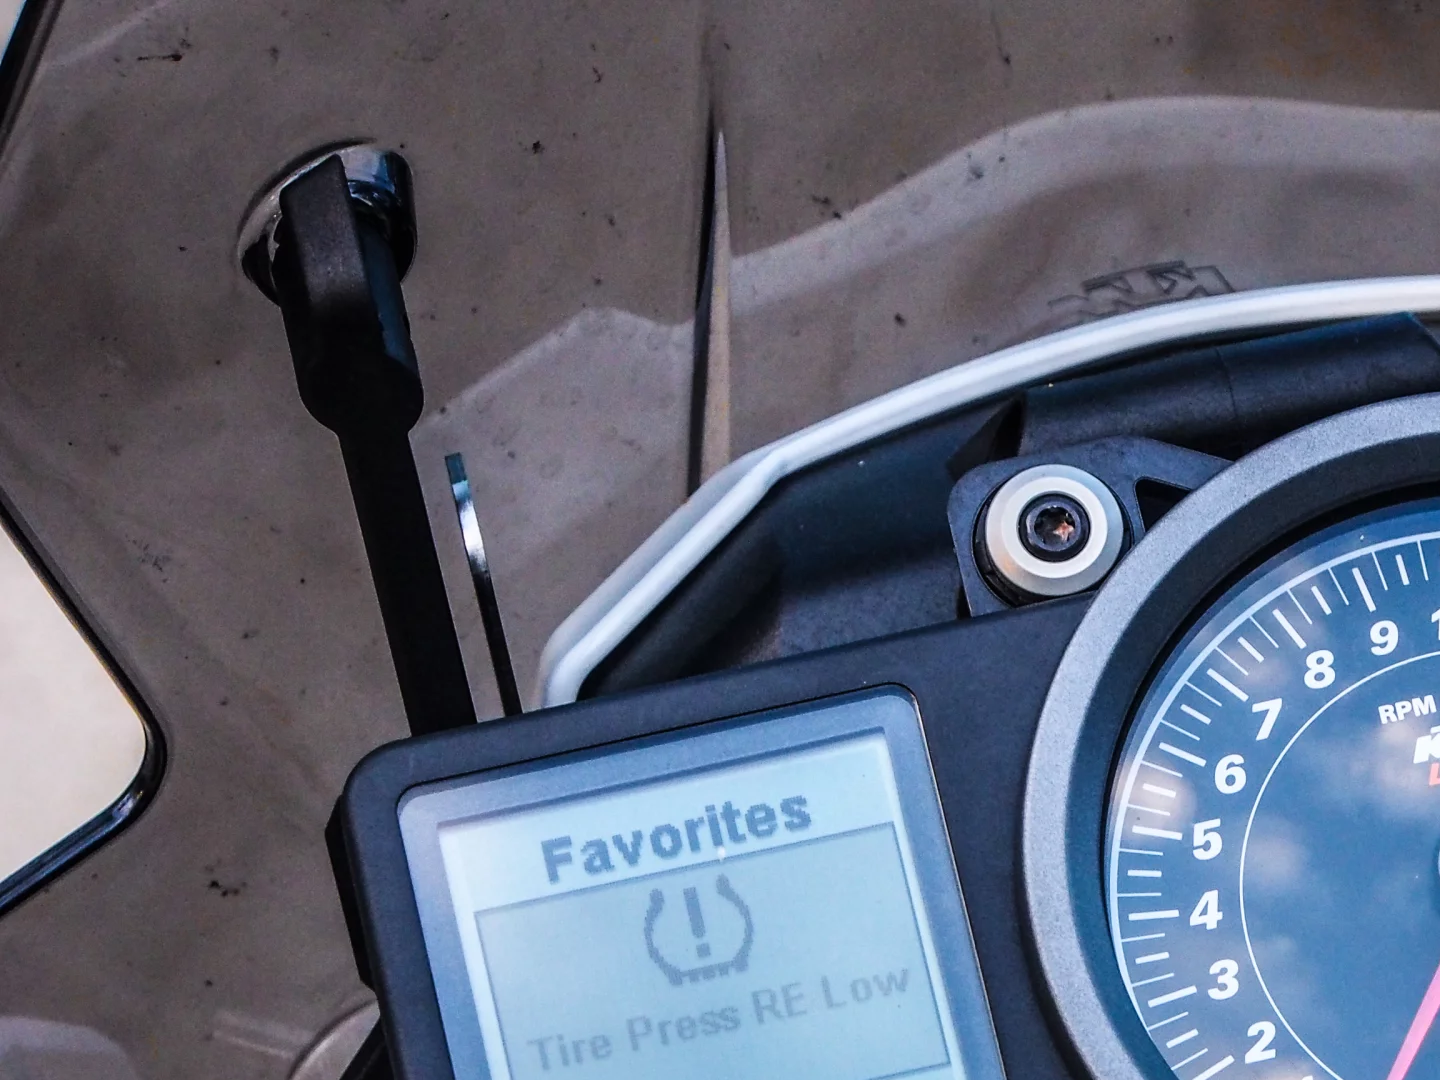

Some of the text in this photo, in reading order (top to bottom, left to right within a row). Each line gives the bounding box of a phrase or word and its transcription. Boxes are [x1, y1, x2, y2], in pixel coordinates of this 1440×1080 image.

[1369, 620, 1399, 656] 9
[1303, 649, 1336, 689] 8
[1252, 699, 1283, 740] 7
[1378, 695, 1437, 725] RPM
[1214, 753, 1247, 794] 6
[540, 794, 813, 885] Favorites
[1191, 819, 1223, 860] 5
[1189, 890, 1223, 930] 4
[1207, 959, 1239, 1000] 3
[528, 967, 911, 1072] Tire Press RE Low
[1245, 1021, 1277, 1064] 2
